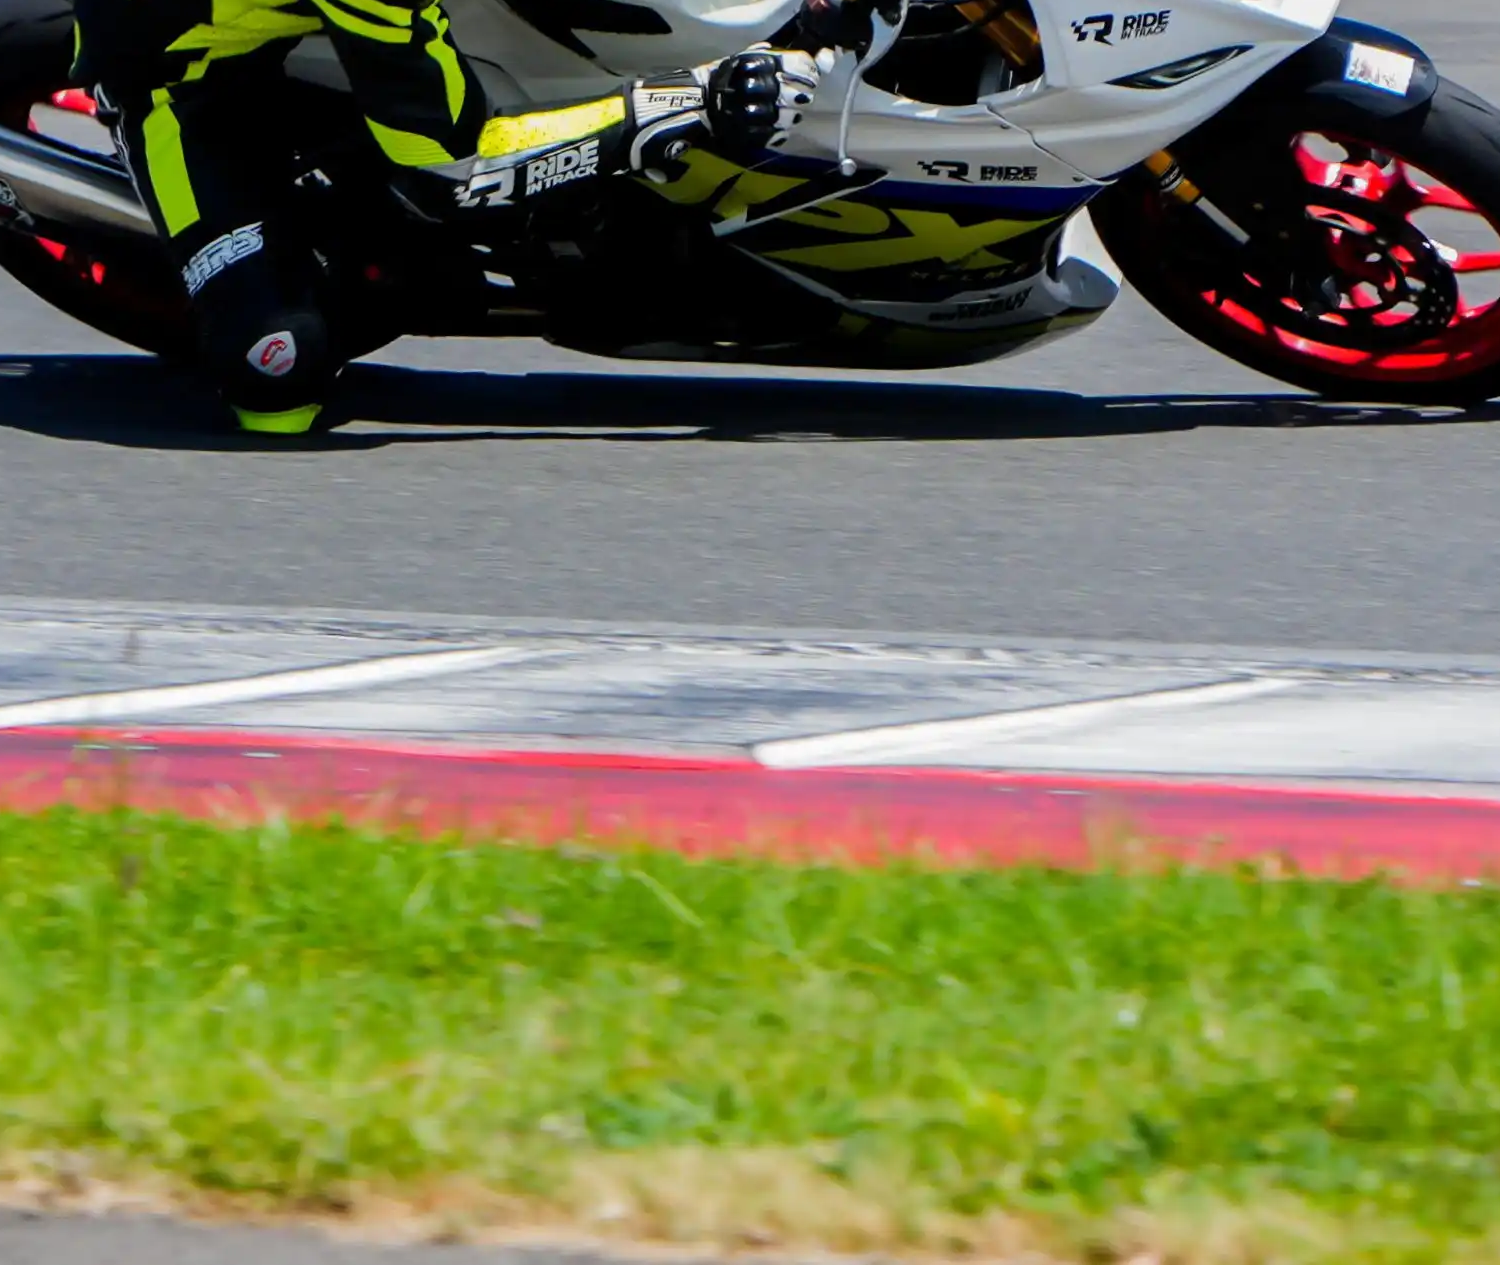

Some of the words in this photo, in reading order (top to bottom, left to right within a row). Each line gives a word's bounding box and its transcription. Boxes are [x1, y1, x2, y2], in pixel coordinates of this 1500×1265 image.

[1123, 10, 1172, 32] RIDE
[526, 138, 600, 184] RIDE
[979, 165, 1038, 179] RIDE
[525, 180, 543, 197] IN
[544, 163, 598, 189] TRACK
